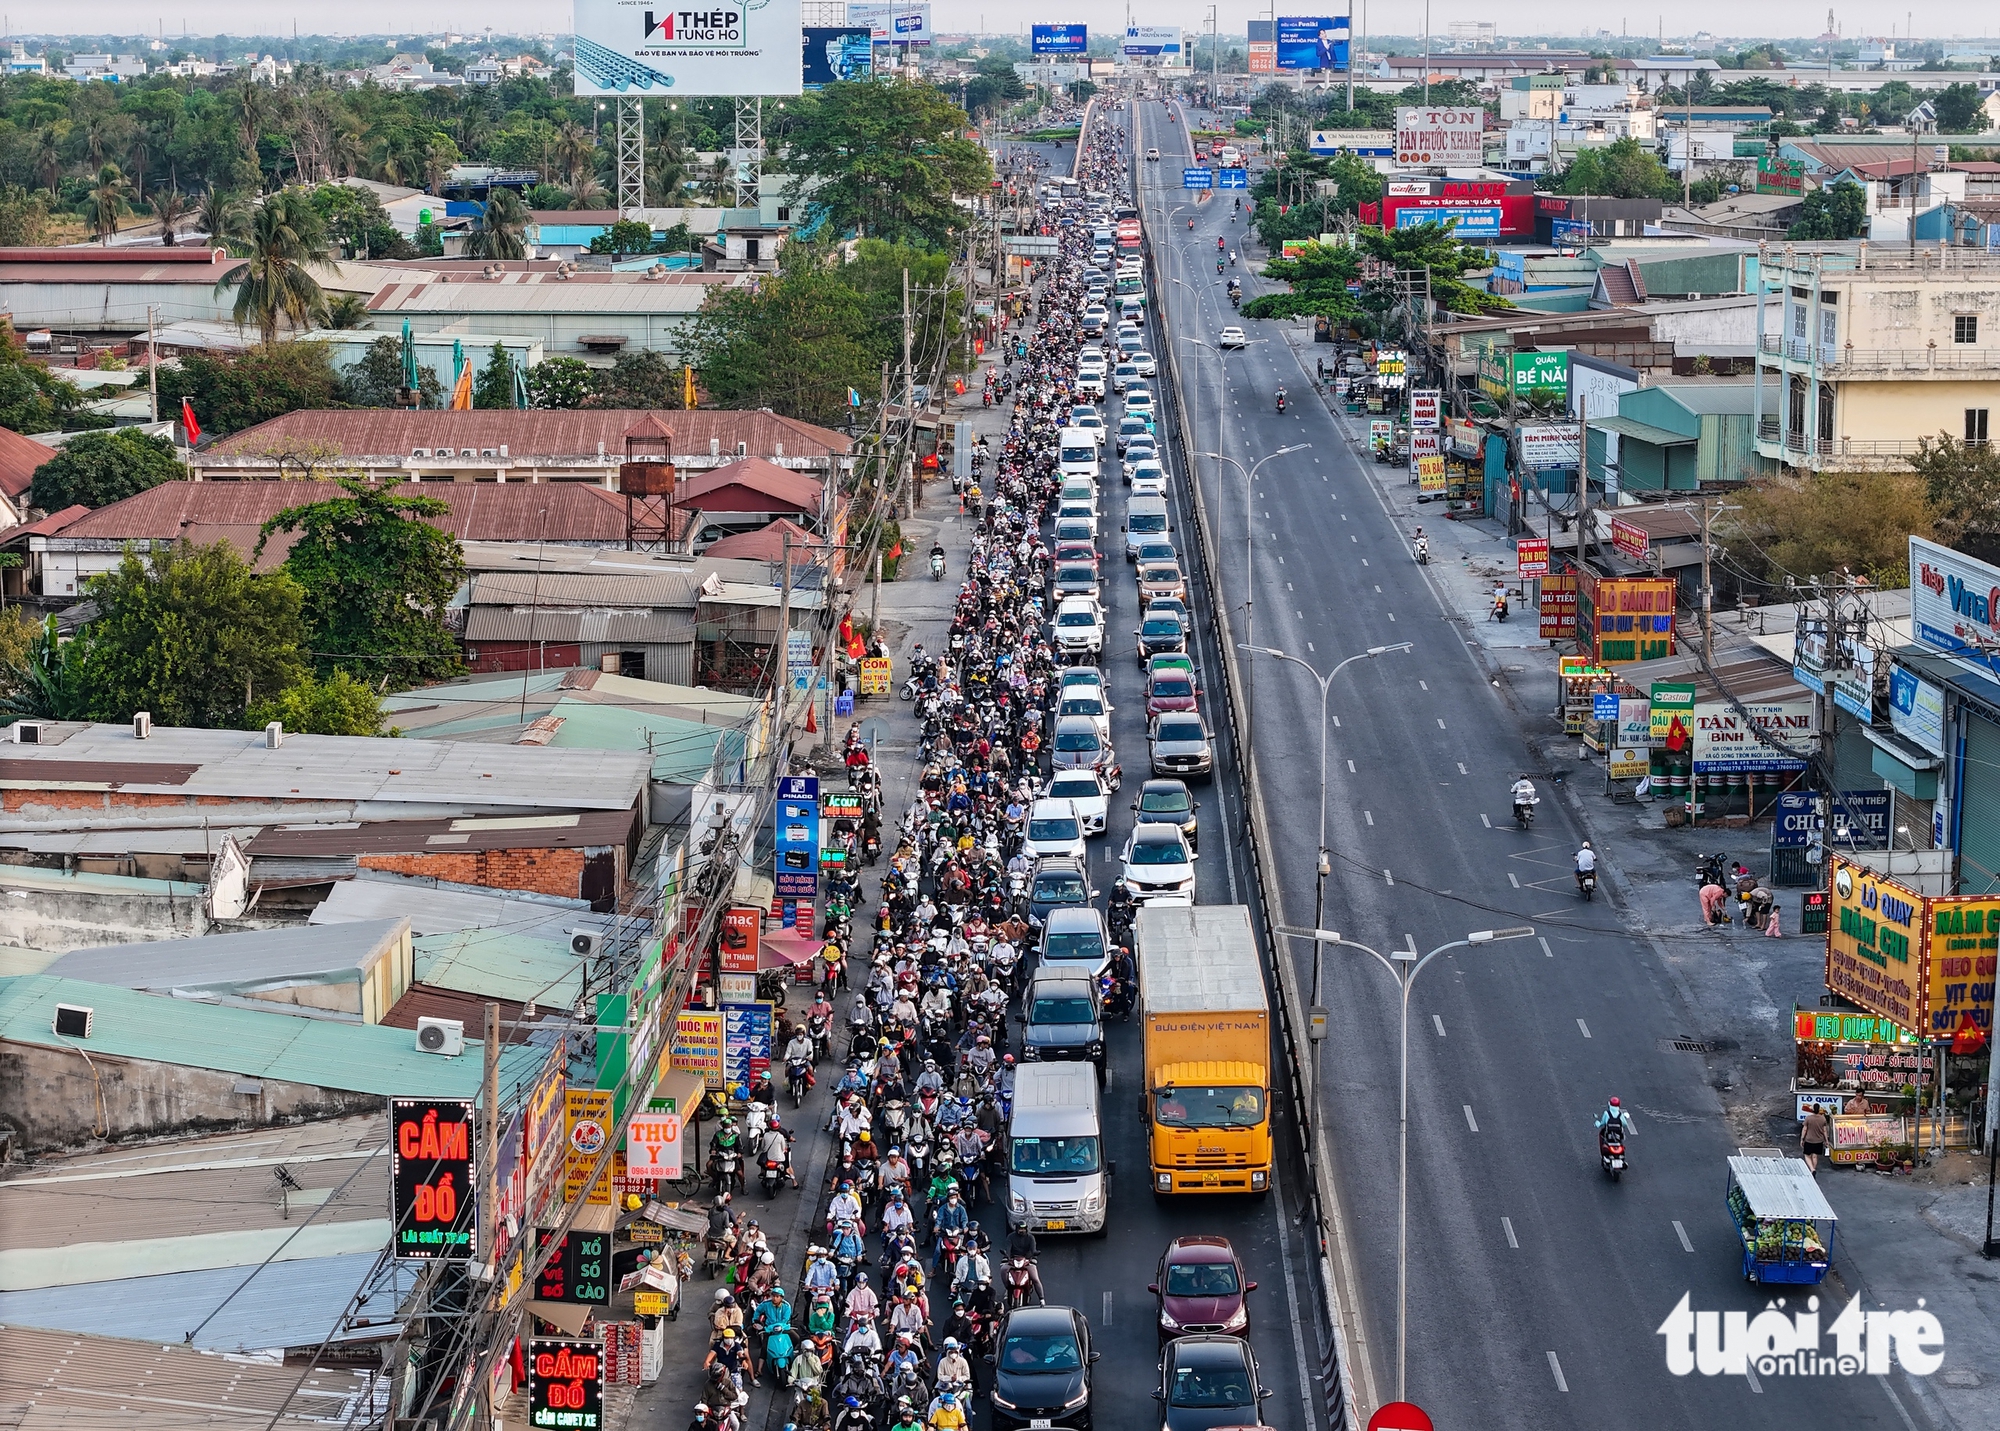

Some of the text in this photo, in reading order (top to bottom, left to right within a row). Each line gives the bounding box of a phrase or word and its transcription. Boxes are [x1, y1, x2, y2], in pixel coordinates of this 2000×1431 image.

[678, 9, 739, 29] THÉP
[676, 29, 739, 40] TUNG HO
[1071, 36, 1082, 44] PVI
[1426, 109, 1475, 124] TÔN
[1400, 125, 1481, 151] TÂN PHƯỚC KHANH
[1441, 182, 1507, 197] MAXXIS
[1535, 355, 1557, 365] QUÁN
[1516, 367, 1537, 384] BÉ
[1416, 397, 1436, 407] NHÀ
[1414, 407, 1437, 418] NGHỈ
[1414, 437, 1436, 448] NHÀ
[1919, 562, 1945, 598] Thép
[1541, 591, 1576, 602] HỦ TIẾU
[1601, 585, 1670, 613] LÒ BÁNH MÌ
[1561, 604, 1576, 613] NON
[1541, 615, 1576, 625] ĐUÔI HEO
[1541, 626, 1557, 637] TÔM
[1602, 640, 1667, 661] MINH LAN
[863, 659, 888, 669] CƠM
[1662, 693, 1689, 702] Castrol
[1620, 704, 1651, 722] PH
[1651, 712, 1668, 726] DẦU
[1697, 714, 1738, 729] TÂN
[1707, 731, 1744, 742] (BÌNH
[1848, 795, 1864, 805] TÔN
[1865, 794, 1886, 805] THÉP
[1783, 809, 1816, 831] CHÍ
[1810, 894, 1822, 904] LÒ
[1861, 881, 1915, 928] LÒ QUAY
[1805, 903, 1826, 912] QUAY
[1806, 922, 1823, 932] CHI
[1935, 905, 1984, 936] NĂM
[1879, 926, 1909, 964] CHI
[1946, 936, 1976, 951] (BÌNH
[733, 952, 755, 961] THÀNH
[1941, 956, 1972, 977] HEO
[735, 980, 752, 991] QUY
[1945, 983, 1968, 1006] VỊT
[1932, 1004, 1958, 1031] SỐT
[1155, 1022, 1260, 1033] BƯU ĐIỆN VIỆT NAM
[1798, 1015, 1840, 1039] LÒ HEO
[707, 1048, 718, 1056] LED
[1846, 1053, 1862, 1068] VỊT
[1863, 1053, 1886, 1068] QUAY
[1845, 1069, 1908, 1085] VỊT NƯỚNG VỊT
[630, 1118, 678, 1143] THÚ
[646, 1145, 663, 1164] Y
[1838, 1150, 1852, 1161] LÒ
[631, 1166, 678, 1176] 0964 859 871
[627, 1185, 640, 1193] 832
[580, 1236, 602, 1256] XỔ
[580, 1260, 600, 1278] SỐ
[575, 1281, 605, 1300] CÀO
[584, 1411, 597, 1427] XE
